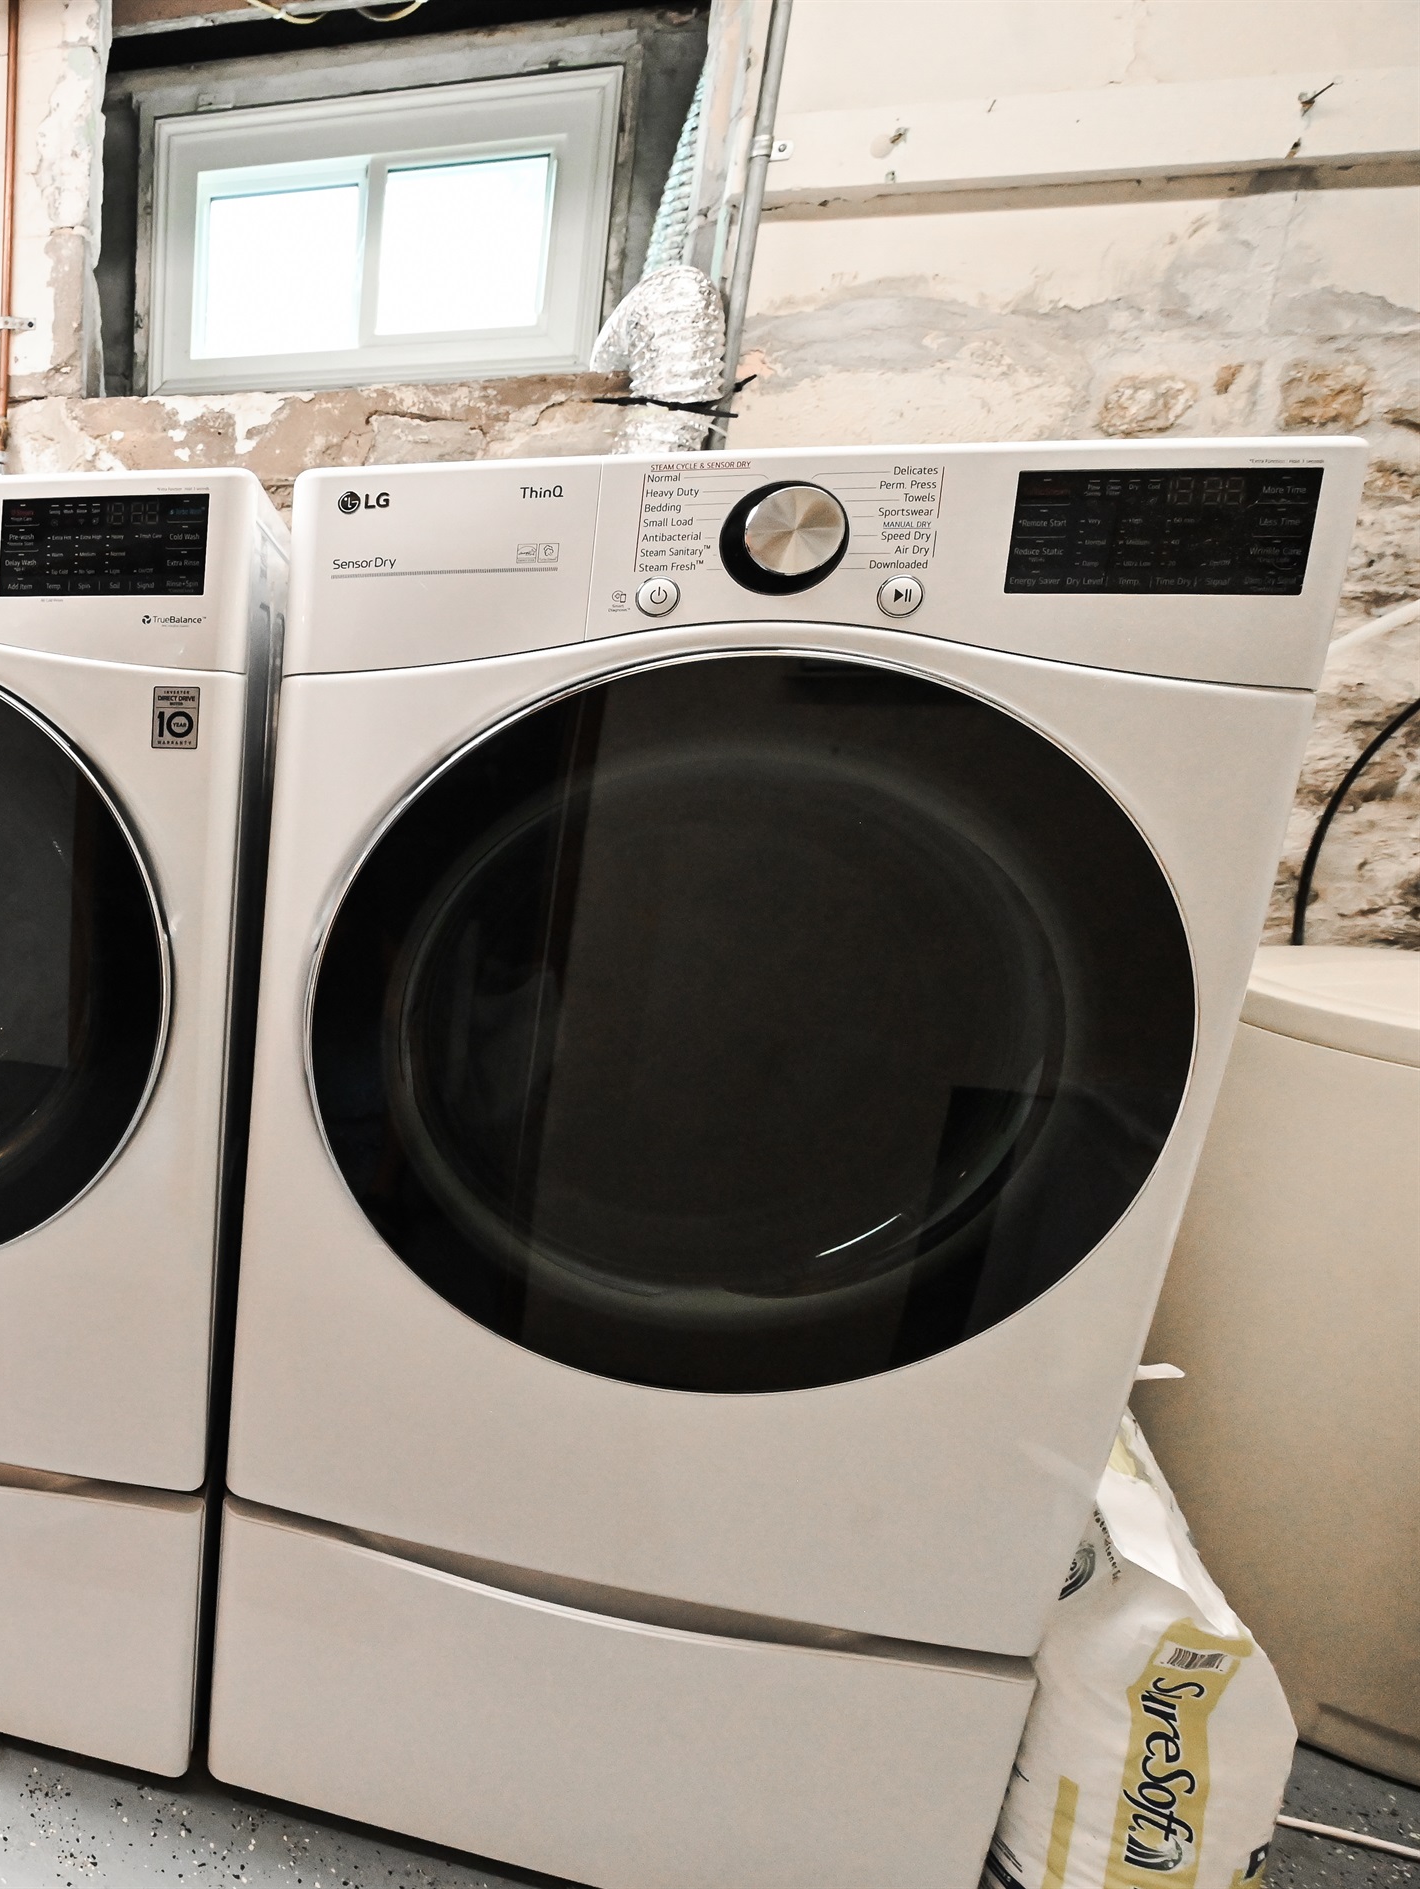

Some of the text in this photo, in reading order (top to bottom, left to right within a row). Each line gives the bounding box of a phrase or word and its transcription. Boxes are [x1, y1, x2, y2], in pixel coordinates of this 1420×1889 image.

[651, 463, 674, 471] STEAM
[676, 462, 697, 470] CYCLE
[707, 461, 735, 469] SENSOR
[736, 460, 751, 468] DRY
[893, 466, 939, 475] Delicates
[647, 473, 681, 483] Normal
[879, 480, 937, 490] Perm. Press
[1262, 486, 1307, 494] More Time
[520, 485, 564, 499] ThinQ
[645, 487, 700, 498] Heavy Duty
[364, 492, 390, 509] LG
[903, 493, 936, 502] Towels
[644, 503, 682, 513] Bedding
[878, 507, 934, 518] Sportswear
[643, 517, 694, 527] Small Load
[1049, 519, 1067, 527] Start
[1280, 518, 1301, 526] Time
[641, 532, 702, 542] Antibacterial
[881, 531, 931, 542] Speed Dry
[640, 548, 666, 558] Steam
[894, 545, 930, 556] Air Dry
[1014, 547, 1064, 555] Reduce Static
[5, 559, 21, 567] Delay
[639, 563, 668, 573] Steam
[869, 560, 928, 569] Downloaded
[136, 582, 155, 590] Signal
[1010, 577, 1061, 587] Energy Saver
[1066, 577, 1104, 586] Dry Level
[1155, 577, 1192, 587] Time Dry
[1205, 578, 1230, 587] Signal
[157, 711, 194, 738] 10
